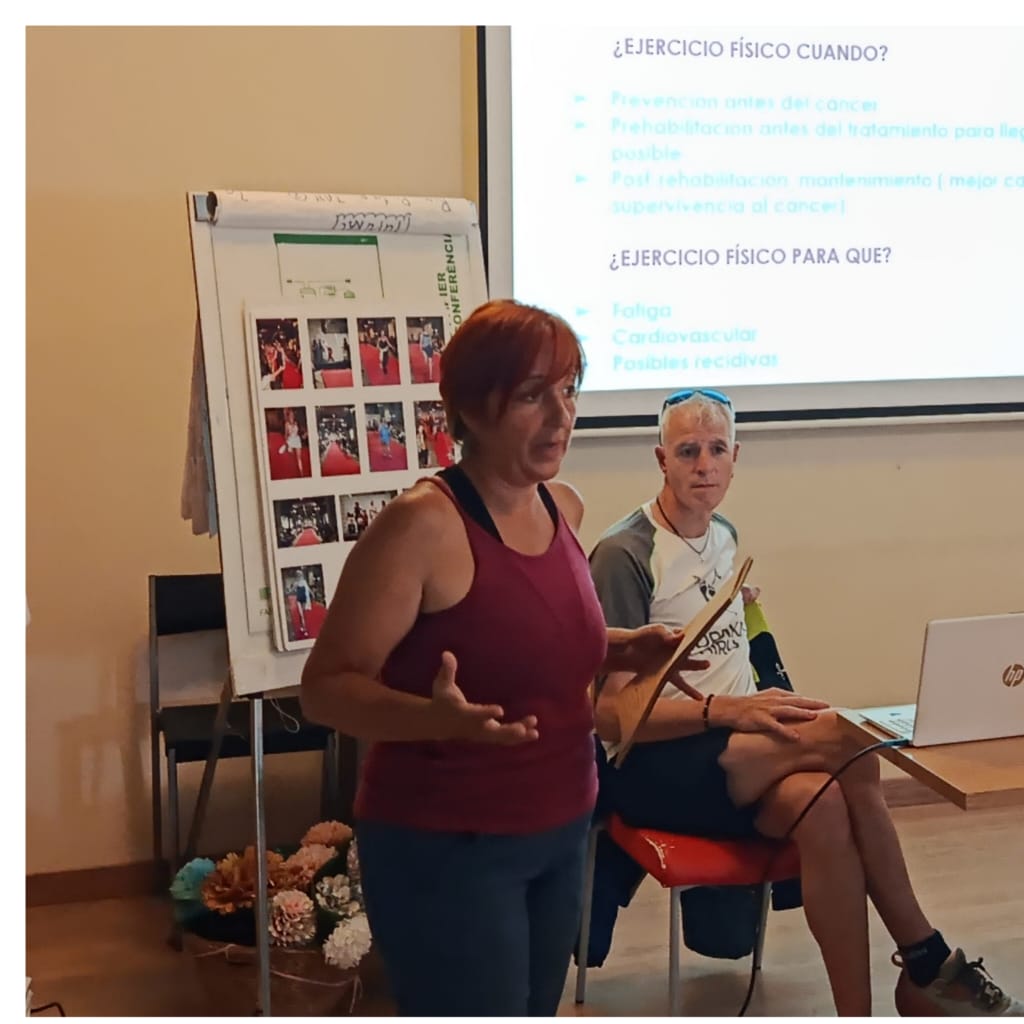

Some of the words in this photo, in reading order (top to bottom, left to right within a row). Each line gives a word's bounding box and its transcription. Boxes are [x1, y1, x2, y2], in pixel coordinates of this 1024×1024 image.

[613, 38, 724, 58] ¿EJERCICIO
[730, 37, 791, 59] FÍSICO
[796, 43, 888, 62] CUANDO?
[724, 95, 775, 111] antes
[781, 95, 809, 111] del
[759, 121, 808, 137] antes
[815, 121, 842, 138] del
[848, 122, 948, 139] tratamiento
[954, 125, 994, 140] para
[611, 145, 682, 163] posible
[611, 170, 652, 188] Post
[799, 172, 932, 188] mantenimiento
[949, 174, 997, 190] mejor
[611, 198, 745, 216] supervivencia
[751, 198, 768, 214] al
[609, 248, 720, 271] ¿EJERCICIO
[726, 244, 786, 265] FÍSICO
[792, 247, 840, 264] PARA
[845, 246, 892, 264] QUE?
[612, 302, 672, 321] Fatiga
[612, 327, 757, 346] Cardiovascular
[612, 353, 689, 372] Posibles
[695, 351, 779, 370] recidivas
